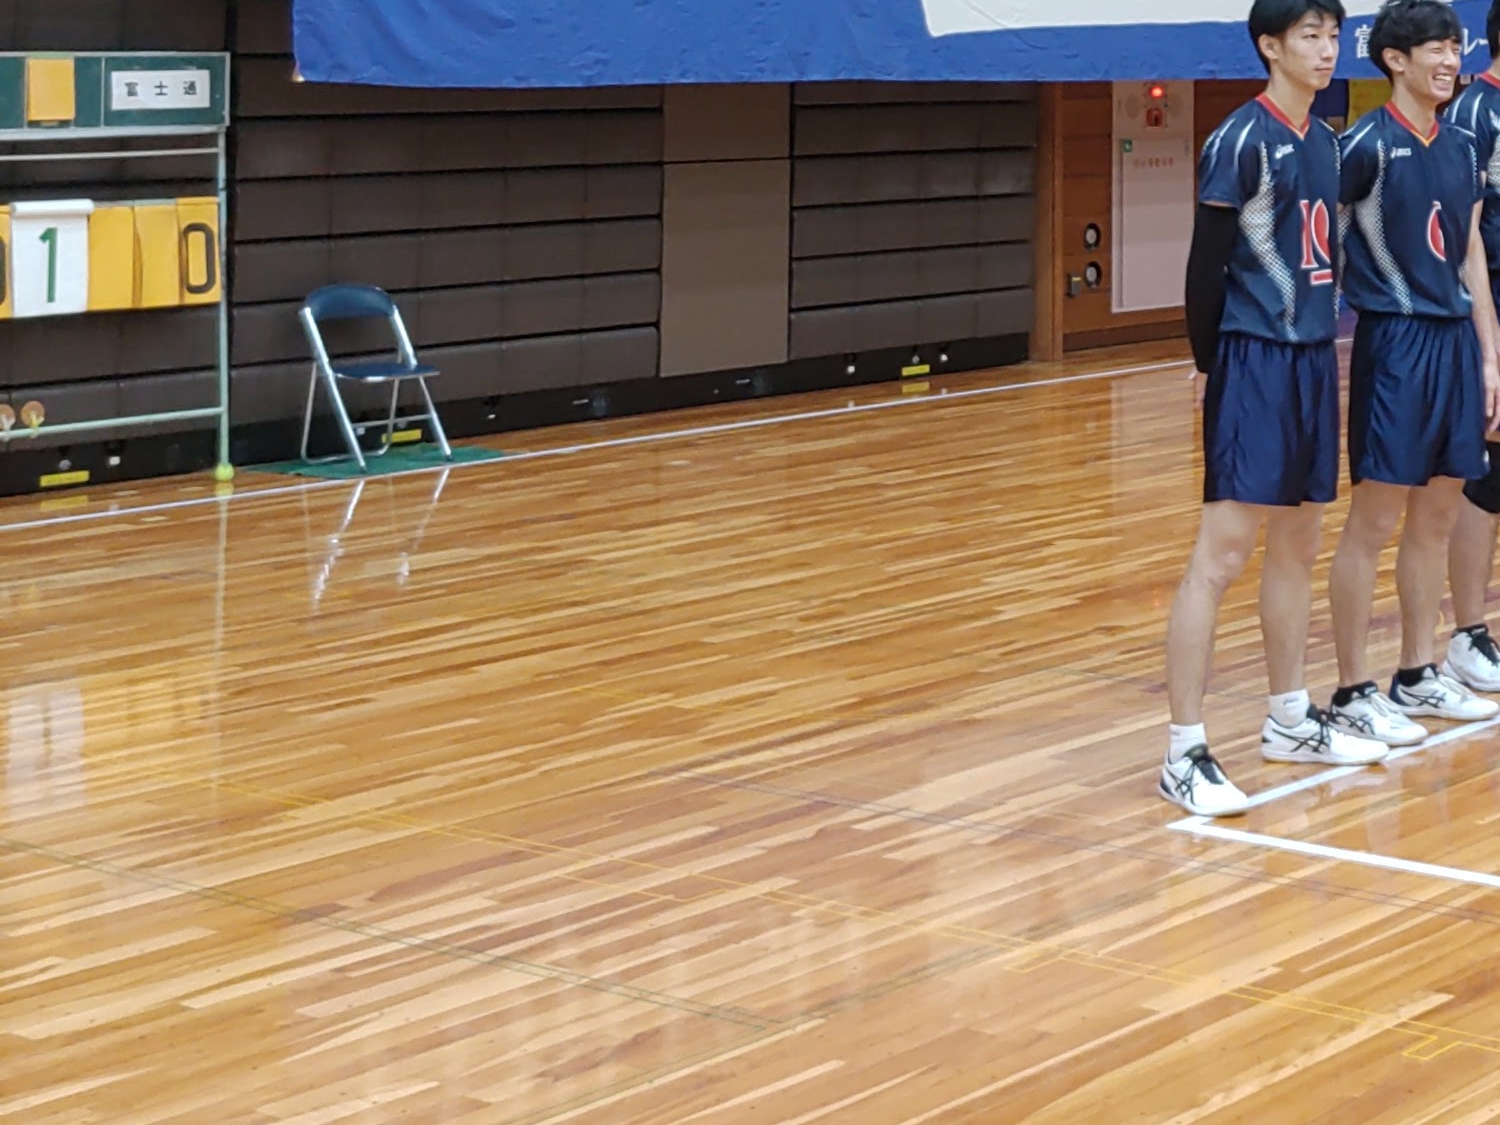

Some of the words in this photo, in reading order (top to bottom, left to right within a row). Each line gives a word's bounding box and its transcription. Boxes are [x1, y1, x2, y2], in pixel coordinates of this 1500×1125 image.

[124, 80, 198, 97] 富士通
[38, 226, 59, 304] 1
[182, 221, 217, 295] 0
